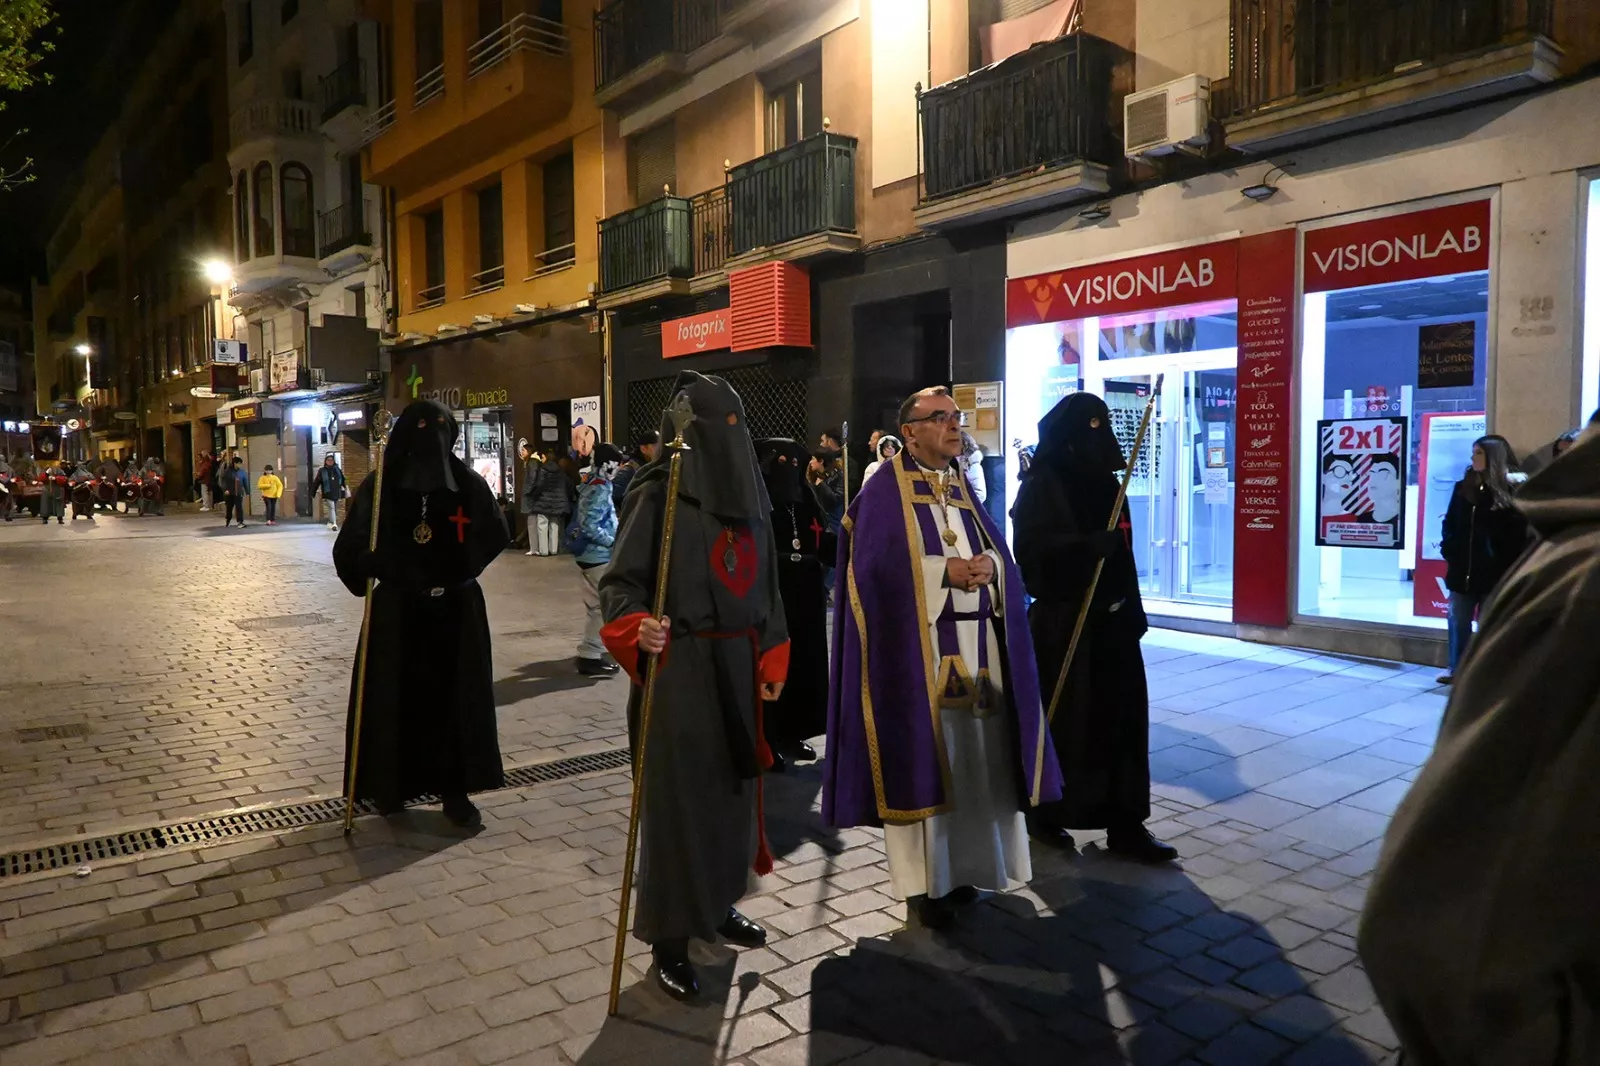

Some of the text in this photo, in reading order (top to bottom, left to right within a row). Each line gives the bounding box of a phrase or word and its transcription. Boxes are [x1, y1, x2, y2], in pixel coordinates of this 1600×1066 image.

[1312, 225, 1481, 274] VISIONLAB
[1063, 258, 1215, 308] VISIONLAB
[678, 314, 726, 341] fotoprix
[1247, 319, 1271, 327] GUCCI
[1436, 353, 1474, 364] Lentes
[466, 386, 508, 407] farmacia
[573, 401, 597, 412] PHYTO
[1250, 403, 1275, 411] TOUS
[1249, 422, 1276, 431] VOGUE
[1339, 424, 1384, 450] 2x1
[1241, 459, 1281, 469] Calvin Klein
[1244, 497, 1276, 506] VERSACE
